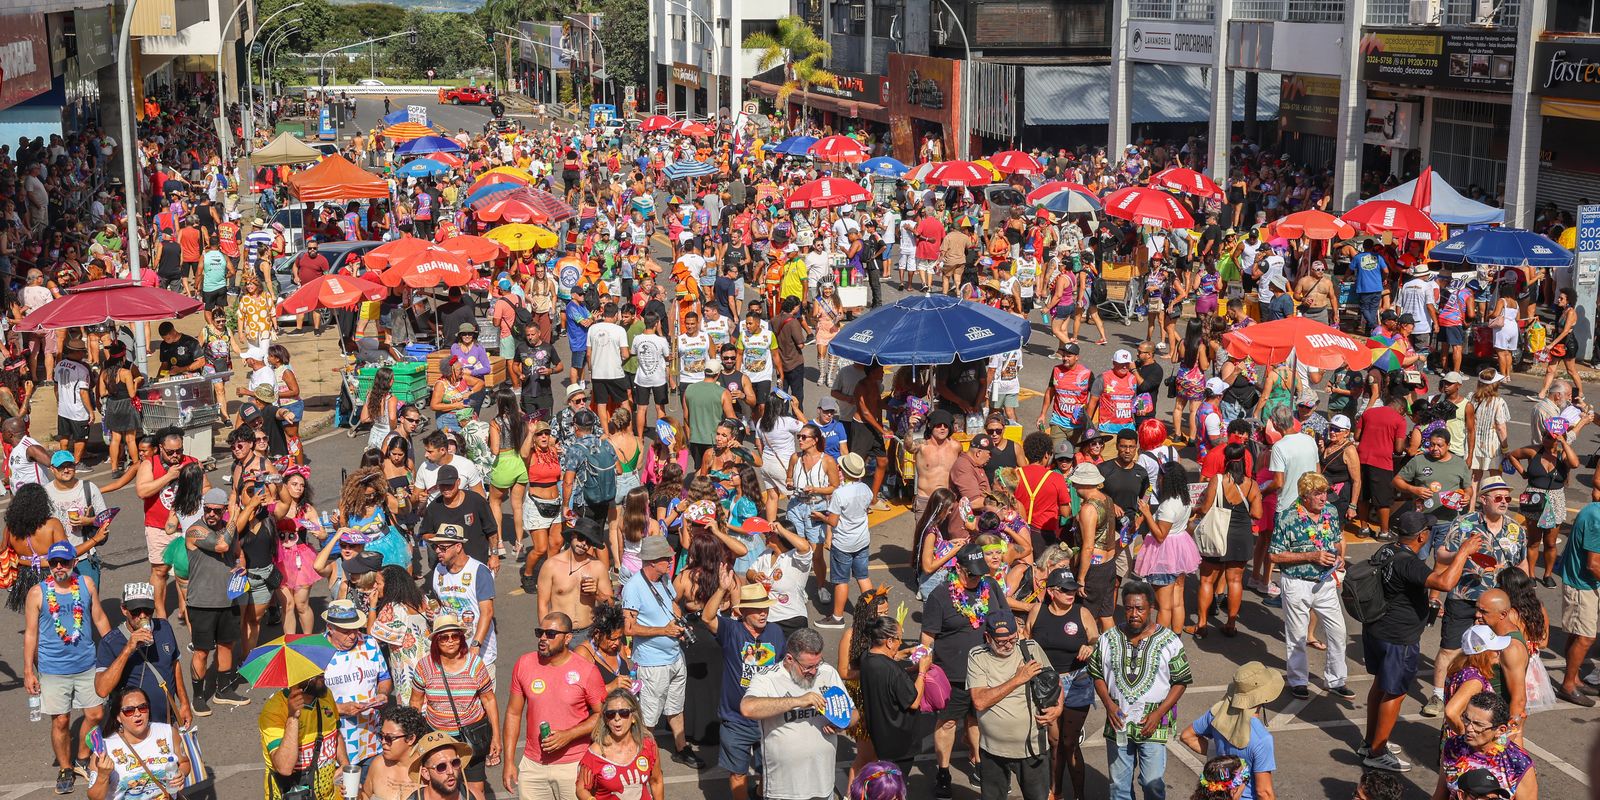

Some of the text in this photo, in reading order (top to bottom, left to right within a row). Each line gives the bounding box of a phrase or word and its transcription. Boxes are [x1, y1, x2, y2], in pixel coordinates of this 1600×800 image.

[1145, 33, 1212, 53] LAVANDERIA COPACABANA
[1118, 191, 1141, 209] BRAHMA
[1142, 216, 1162, 227] BRAHMA
[1383, 207, 1397, 227] BRAHMA
[1414, 231, 1431, 240] BRAHMA
[1581, 228, 1600, 239] 302
[1580, 240, 1600, 251] 303
[416, 260, 461, 273] BRAHMA
[1305, 333, 1358, 351] BRAHMA
[60, 361, 76, 370] CAIXA
[968, 552, 983, 560] POLICE
[344, 674, 352, 683] DA
